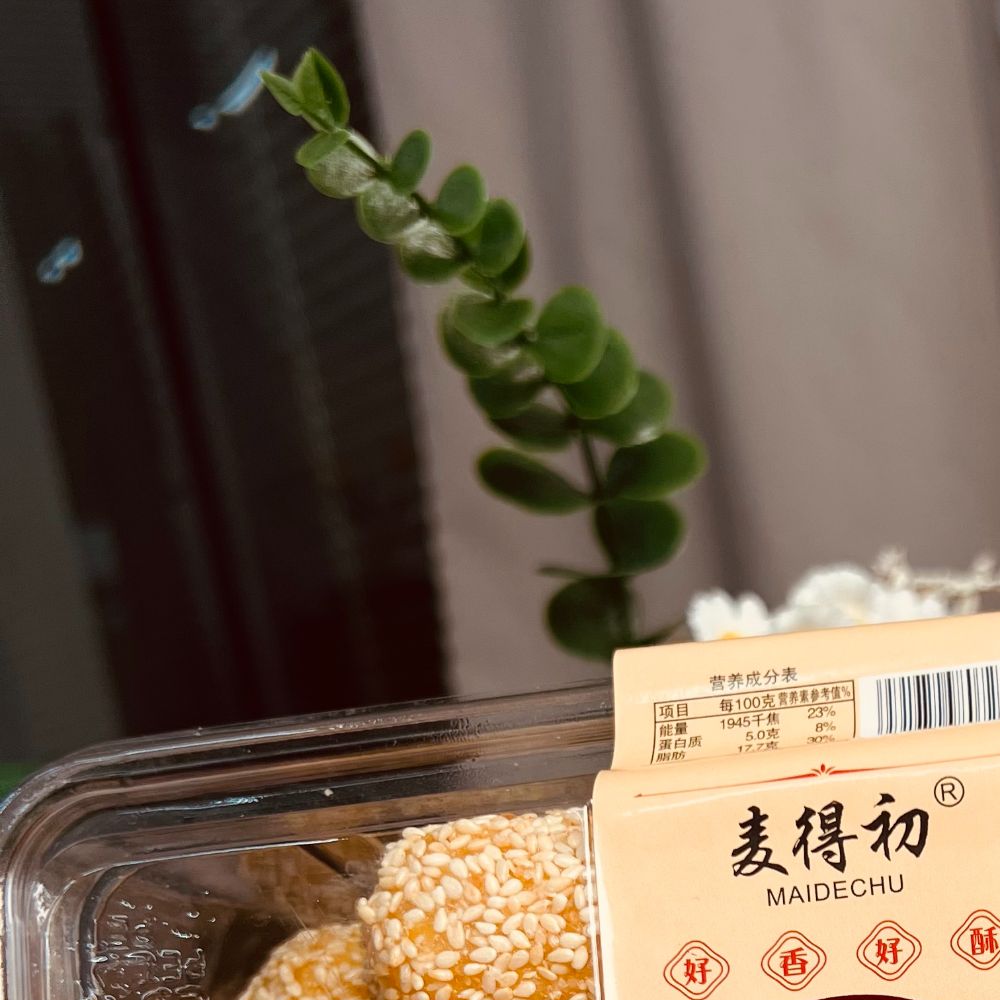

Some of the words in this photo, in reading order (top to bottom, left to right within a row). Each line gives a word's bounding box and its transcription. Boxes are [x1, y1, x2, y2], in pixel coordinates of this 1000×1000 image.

[709, 667, 798, 692] 营养成分表
[659, 702, 689, 719] 项目
[719, 693, 776, 713] 每100克
[778, 685, 851, 708] 营养素参考值%
[658, 735, 702, 751] 蛋白质
[745, 728, 780, 742] 5.0克
[815, 721, 836, 733] 8%
[659, 721, 688, 738] 能量
[720, 712, 780, 731] 1945千焦
[807, 705, 836, 719] 23%
[731, 792, 929, 877] 麦得初
[766, 873, 904, 907] MAIDECHU
[683, 957, 712, 986] 好
[779, 947, 809, 977] 香
[874, 937, 903, 966] 好
[969, 926, 998, 956] 酥
